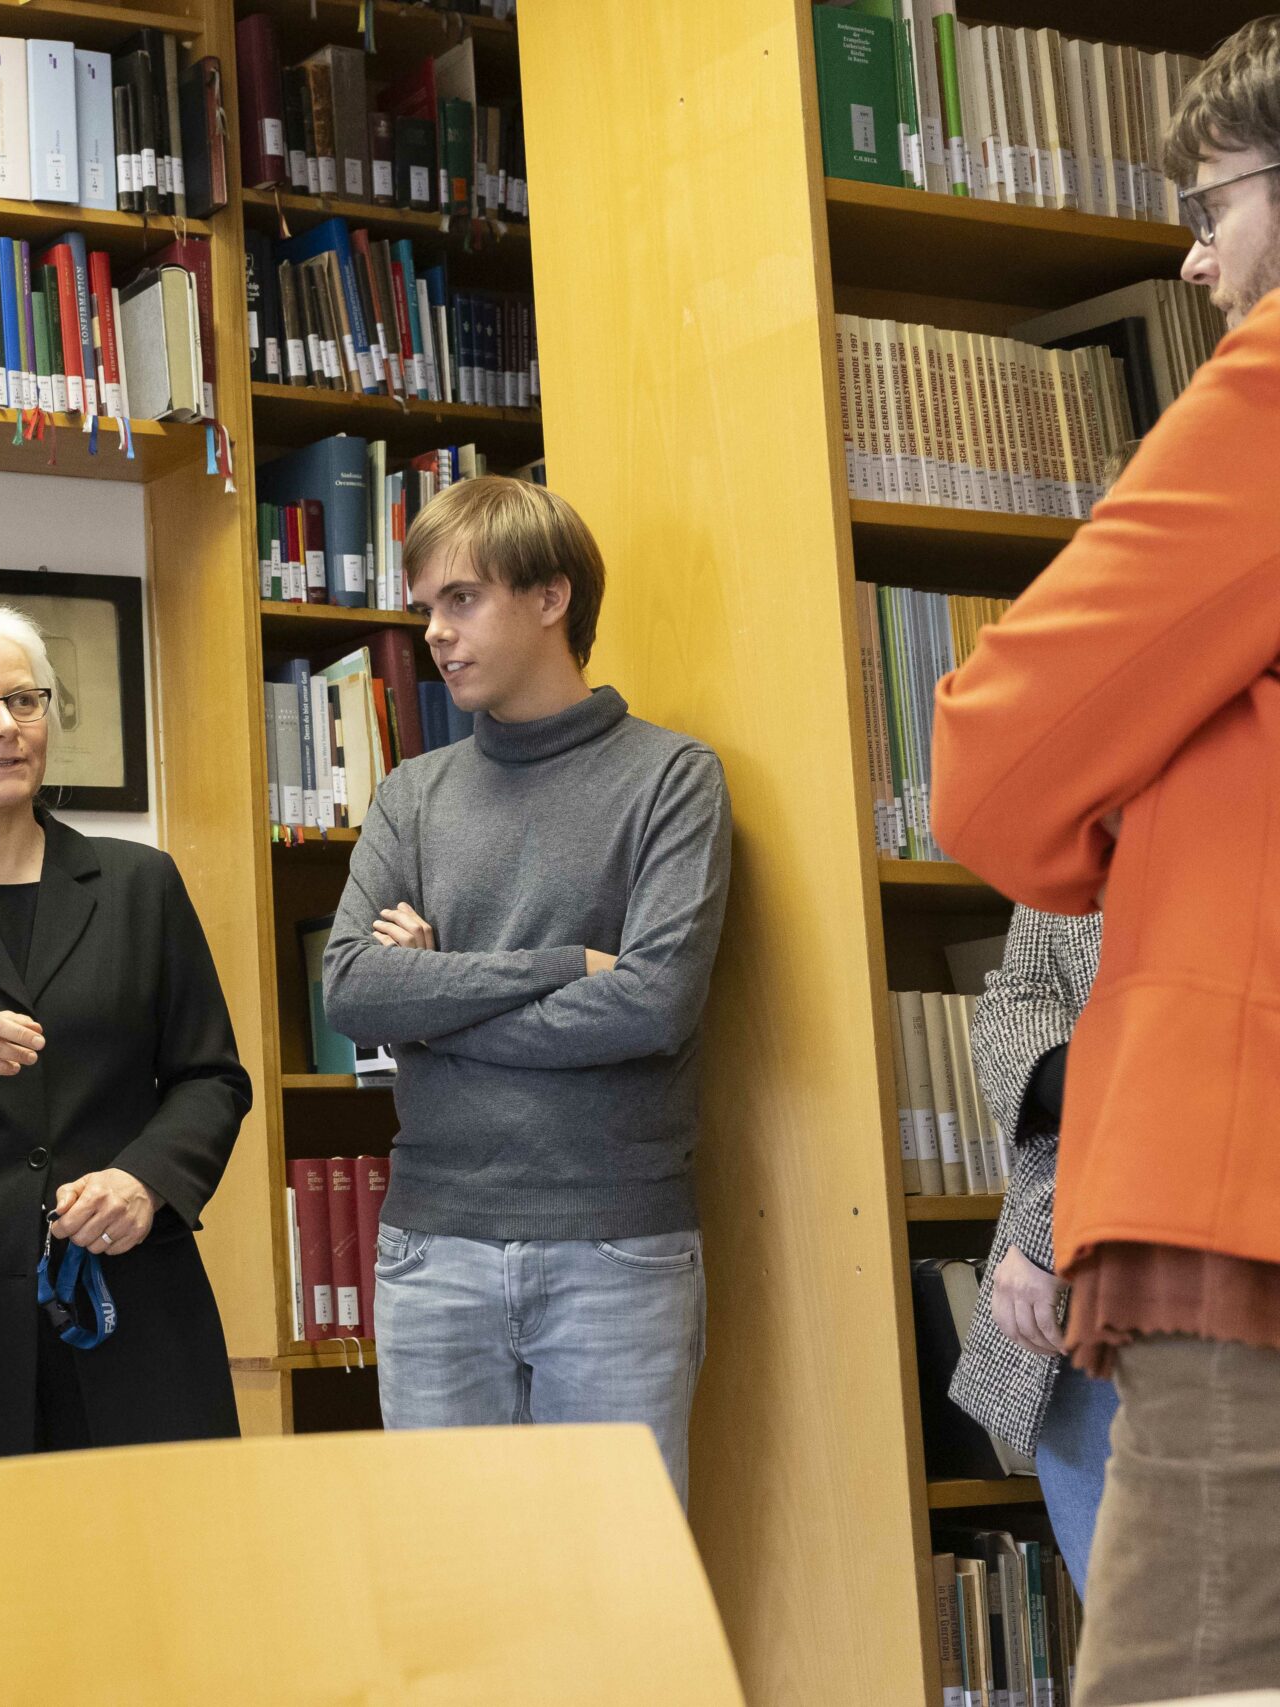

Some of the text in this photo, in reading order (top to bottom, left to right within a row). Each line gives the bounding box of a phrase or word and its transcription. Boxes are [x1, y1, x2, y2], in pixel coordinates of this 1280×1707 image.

[75, 265, 90, 345] KONFIRMATION
[838, 354, 850, 430] GENERALSYNODE
[850, 332, 865, 430] GENERALSYNODE 1997
[862, 341, 877, 430] GENERALSYNODE 1998
[874, 342, 889, 431] GENERALSYNODE 1999
[890, 342, 904, 431] GENERALSYNODE 2000
[898, 342, 913, 430] GENERALSYNODE 2004
[947, 353, 955, 373] 2008
[914, 367, 928, 434] GENERALSYNODE
[929, 371, 942, 438] GENERALSYNODE
[950, 374, 964, 441] GENERALSYNODE
[964, 381, 979, 447] GENERALSYNODE
[980, 379, 993, 444] GENERALSYNODE
[991, 379, 1004, 445] GENERALSYNODE
[999, 361, 1016, 450] GENERALSYNODE 2012
[1010, 361, 1027, 449] GENERALSYNODE 2013
[1023, 388, 1037, 452] GENERALSYNODE
[1034, 390, 1047, 456] GENERALSYNODE
[1042, 391, 1057, 457] GENERALSYNODE
[1050, 394, 1065, 458] GENERALSYNODE
[300, 671, 308, 685] Gott
[303, 715, 310, 723] du
[303, 724, 311, 740] Denn
[332, 1169, 344, 1177] der
[102, 1303, 116, 1335] FAU
[937, 1585, 951, 1663] in East Germany
